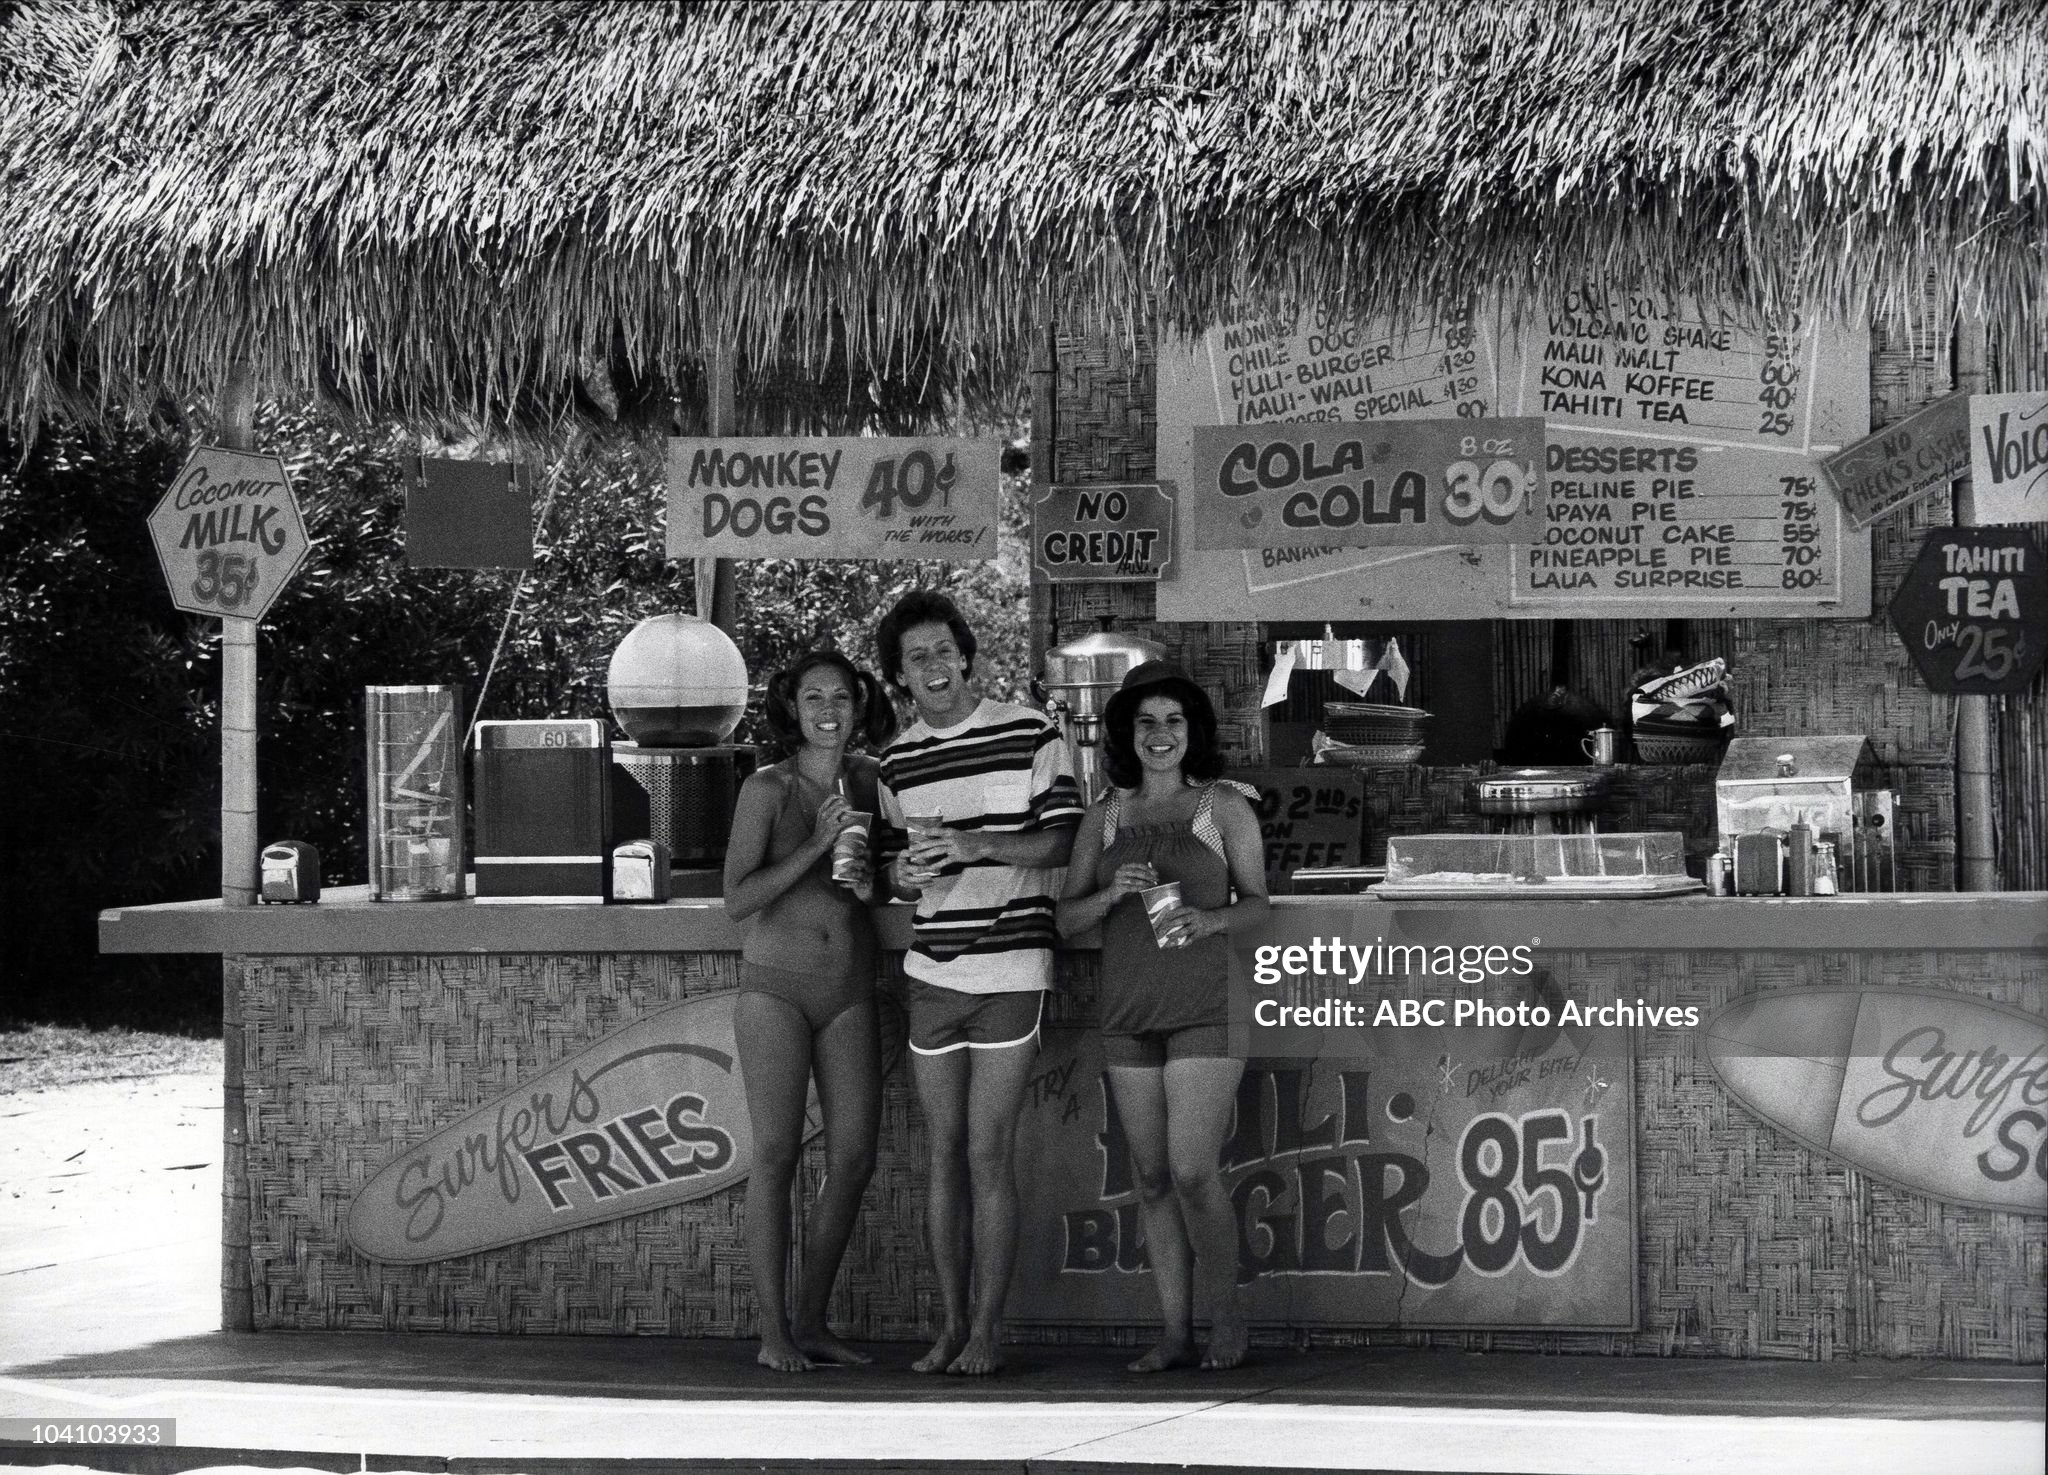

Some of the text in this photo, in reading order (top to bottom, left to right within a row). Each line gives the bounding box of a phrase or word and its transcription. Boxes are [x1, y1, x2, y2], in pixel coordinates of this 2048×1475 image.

[1663, 325, 1731, 351] SHAKE
[1543, 340, 1602, 365] MAUI
[1615, 347, 1680, 372] MALT
[1354, 388, 1433, 420] SPECIAL
[1541, 366, 1797, 410] KONA KOFFEE 40¢
[1539, 390, 1794, 436] TAHITI TEA 25¢
[1218, 439, 1366, 498] COLA
[1460, 436, 1477, 456] 8
[1545, 444, 1698, 474] DESSERTS
[688, 448, 956, 520] MONKEY 40¢
[1282, 460, 1537, 528] COLA 30¢
[1550, 476, 1817, 499] PELINE PIE 75¢
[703, 493, 831, 538] DOGS
[909, 515, 956, 528] WITH
[1074, 490, 1129, 523] NO
[1632, 501, 1677, 522] PIE
[1780, 501, 1817, 521] 75¢
[179, 504, 286, 556] MILK
[884, 527, 987, 547] THE WORKS!
[1662, 524, 1735, 545] CAKE
[1782, 522, 1820, 544] 55¢
[1044, 529, 1159, 566] CREDIT
[1529, 545, 1821, 568] PINEAPPLE PIE 70¢
[1942, 544, 2025, 573] TAHITI
[1530, 567, 1822, 589] LAUA SURPRISE 80¢
[1939, 576, 2020, 619] TEA
[1925, 620, 2026, 680] ONLY 25¢
[1262, 822, 1294, 840] ON
[1025, 1058, 1078, 1108] TRY
[1490, 1068, 1531, 1103] YOUR
[1061, 1093, 1082, 1126] A
[397, 1044, 733, 1243] Surfers
[521, 1091, 736, 1214] FRIES
[1456, 1108, 1609, 1279] 85¢
